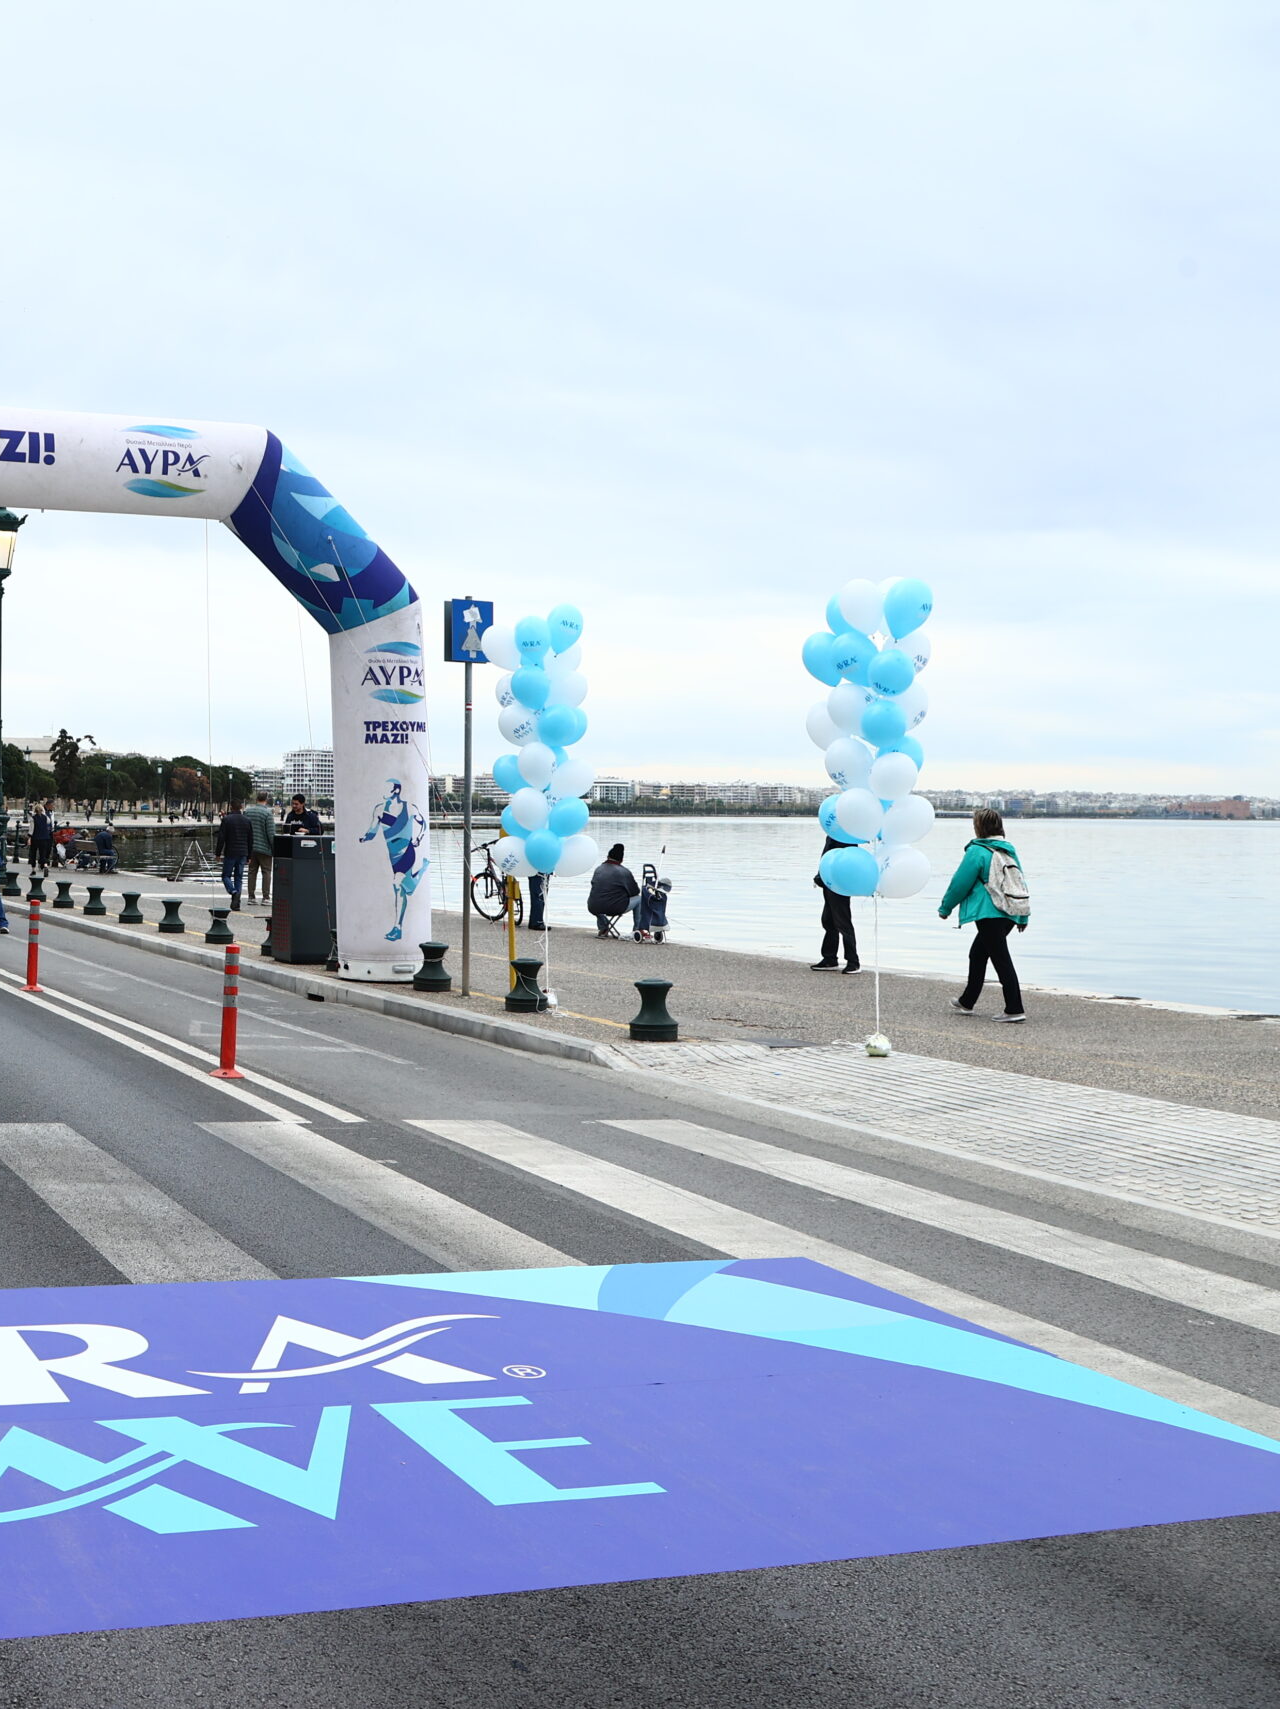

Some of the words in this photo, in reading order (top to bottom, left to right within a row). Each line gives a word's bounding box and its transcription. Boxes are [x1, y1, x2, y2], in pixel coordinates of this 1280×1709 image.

[115, 447, 211, 478] ΑΥΡΑ
[361, 665, 424, 687] ΑΥΡΑ
[363, 720, 426, 733] ΤΡΕΧΟΥΜΕ
[364, 733, 409, 744] ΜΑΖΙ!
